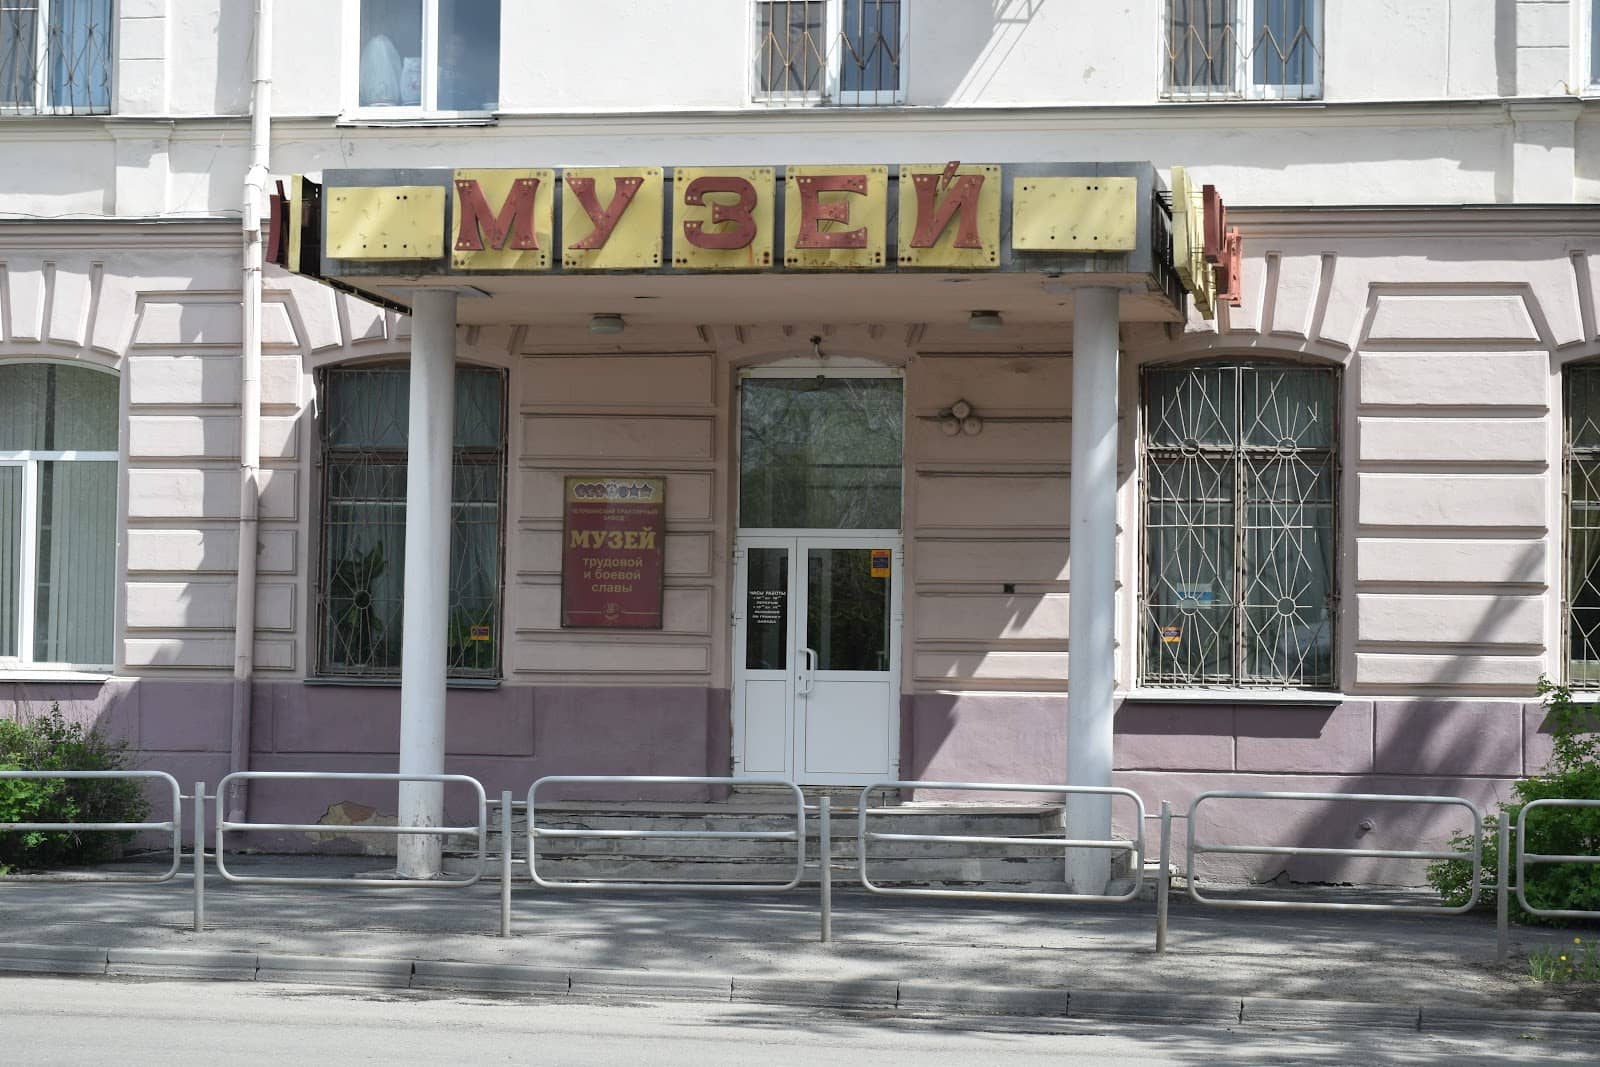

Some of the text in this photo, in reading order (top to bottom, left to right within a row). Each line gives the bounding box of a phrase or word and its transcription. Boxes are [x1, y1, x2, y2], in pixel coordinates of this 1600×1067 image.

[454, 161, 985, 251] МУЗЕЙ
[570, 526, 656, 549] МУЗЕЙ
[583, 557, 643, 568] трудовой
[583, 569, 641, 580] и боевой
[591, 584, 633, 592] славы
